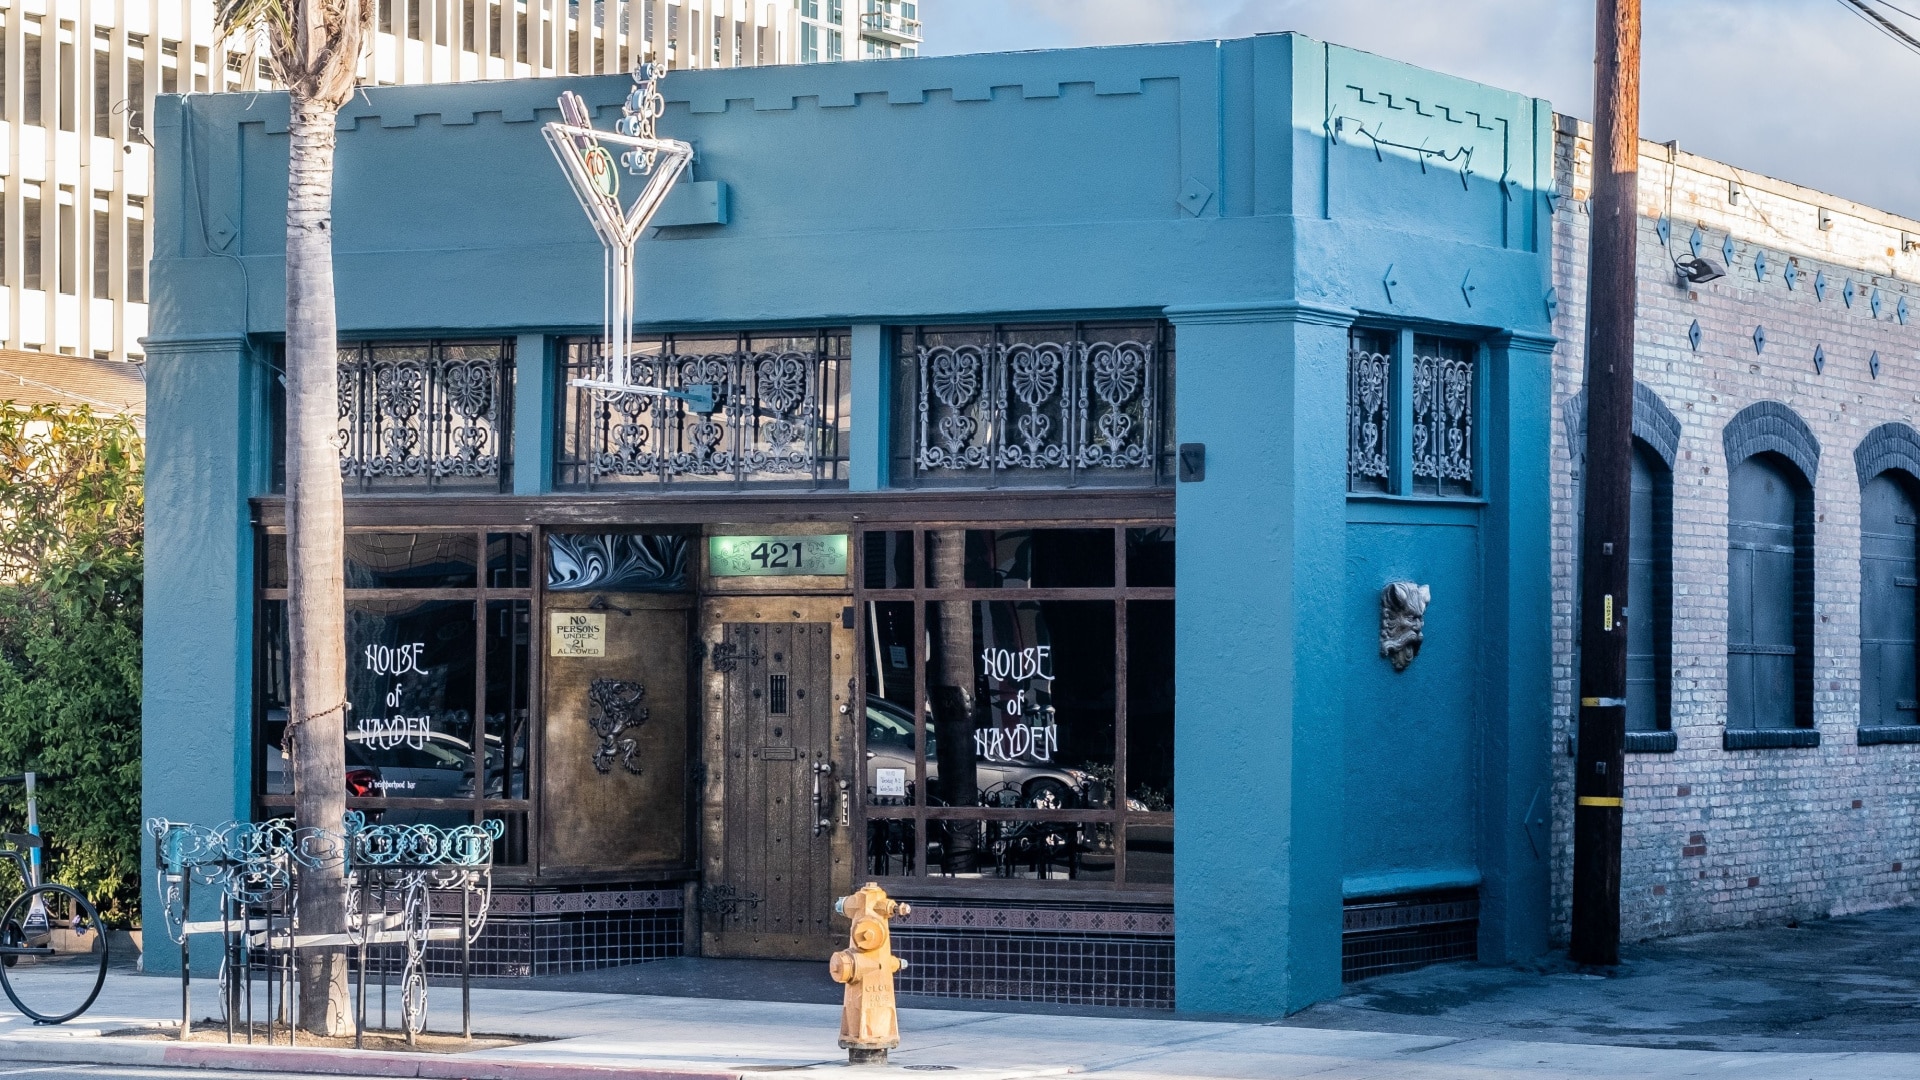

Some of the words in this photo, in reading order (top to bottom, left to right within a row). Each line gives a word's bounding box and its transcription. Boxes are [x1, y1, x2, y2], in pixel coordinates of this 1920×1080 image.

[750, 542, 803, 568] 421
[556, 625, 600, 634] PERSONS
[570, 615, 587, 625] NO
[571, 639, 584, 648] 21
[364, 643, 429, 677] HOUSE
[981, 645, 1056, 682] HOUSE
[386, 683, 402, 707] of
[1007, 689, 1025, 715] of
[357, 714, 430, 750] HAYDEN
[973, 723, 1058, 761] HAYDEN
